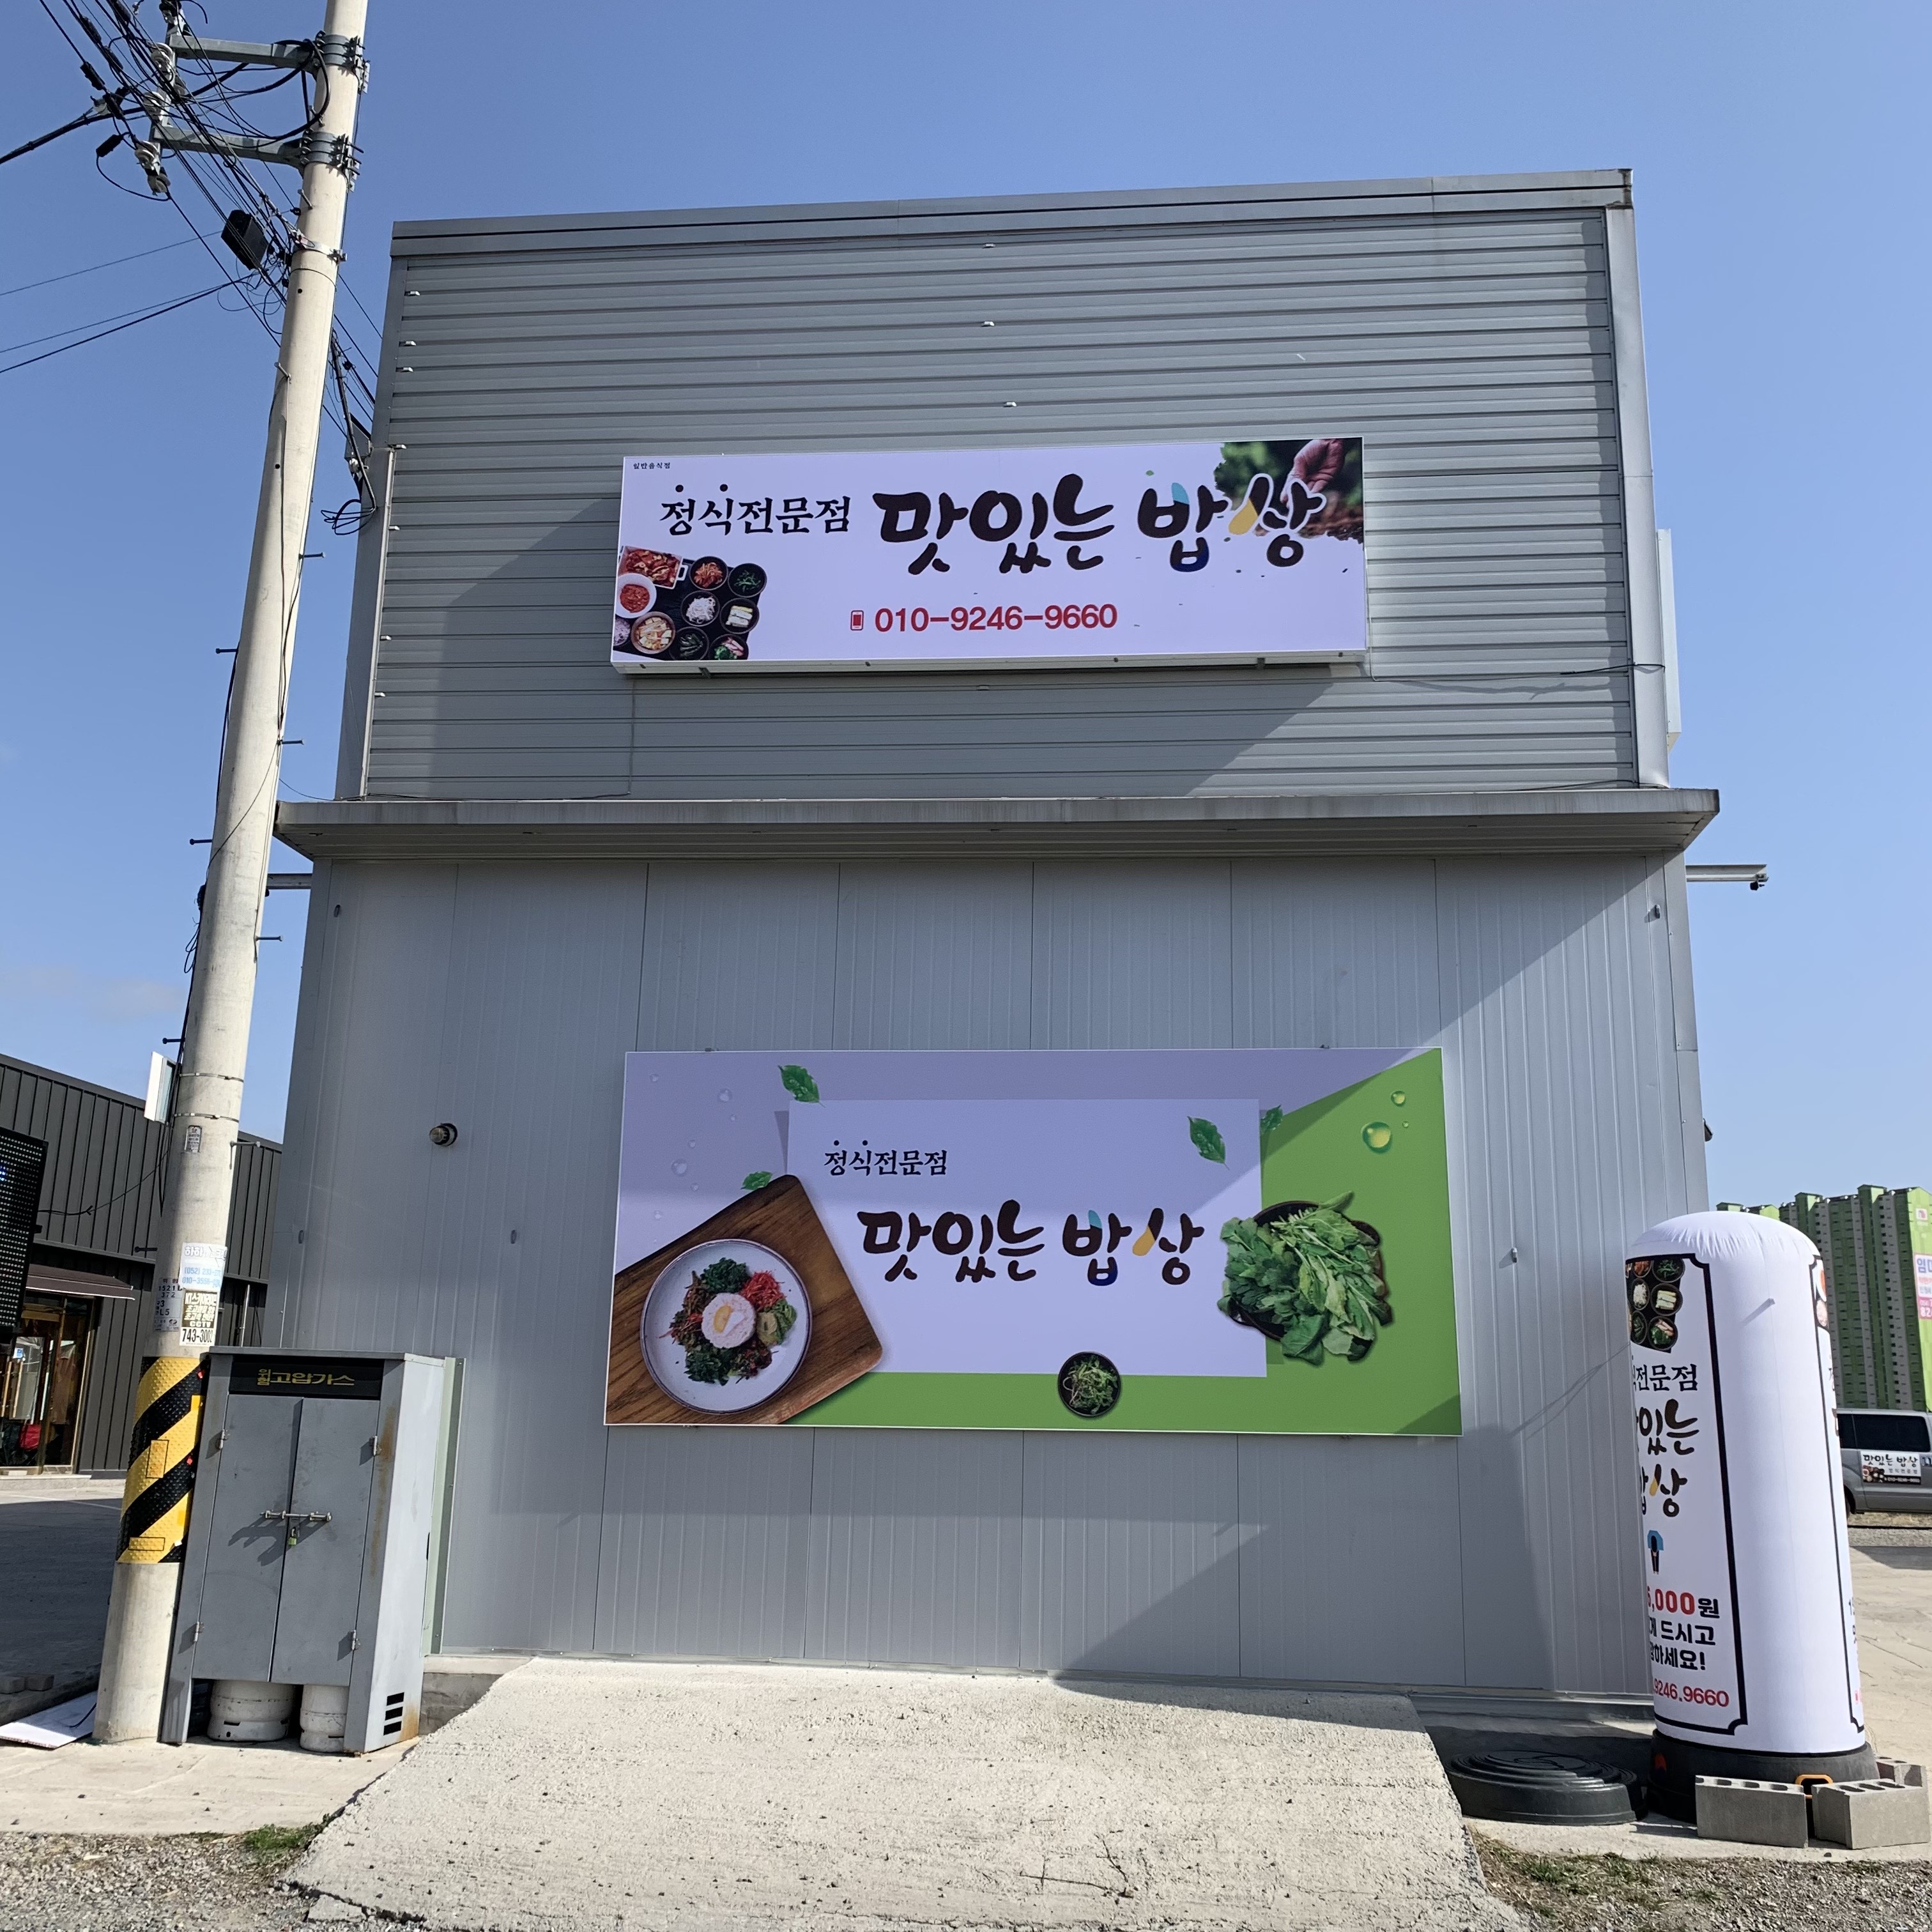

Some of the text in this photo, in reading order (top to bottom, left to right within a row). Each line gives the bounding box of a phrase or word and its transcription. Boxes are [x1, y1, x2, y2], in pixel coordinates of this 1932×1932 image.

[659, 473, 1324, 576] 정식전문점 맛있는 밥상
[875, 603, 1118, 632] 010-9246-9660
[824, 1148, 947, 1177] 정식전문점
[857, 1199, 1205, 1287] 맛있는 밥상
[1637, 1398, 1699, 1455] 있는
[1661, 1620, 1716, 1646] 드시고
